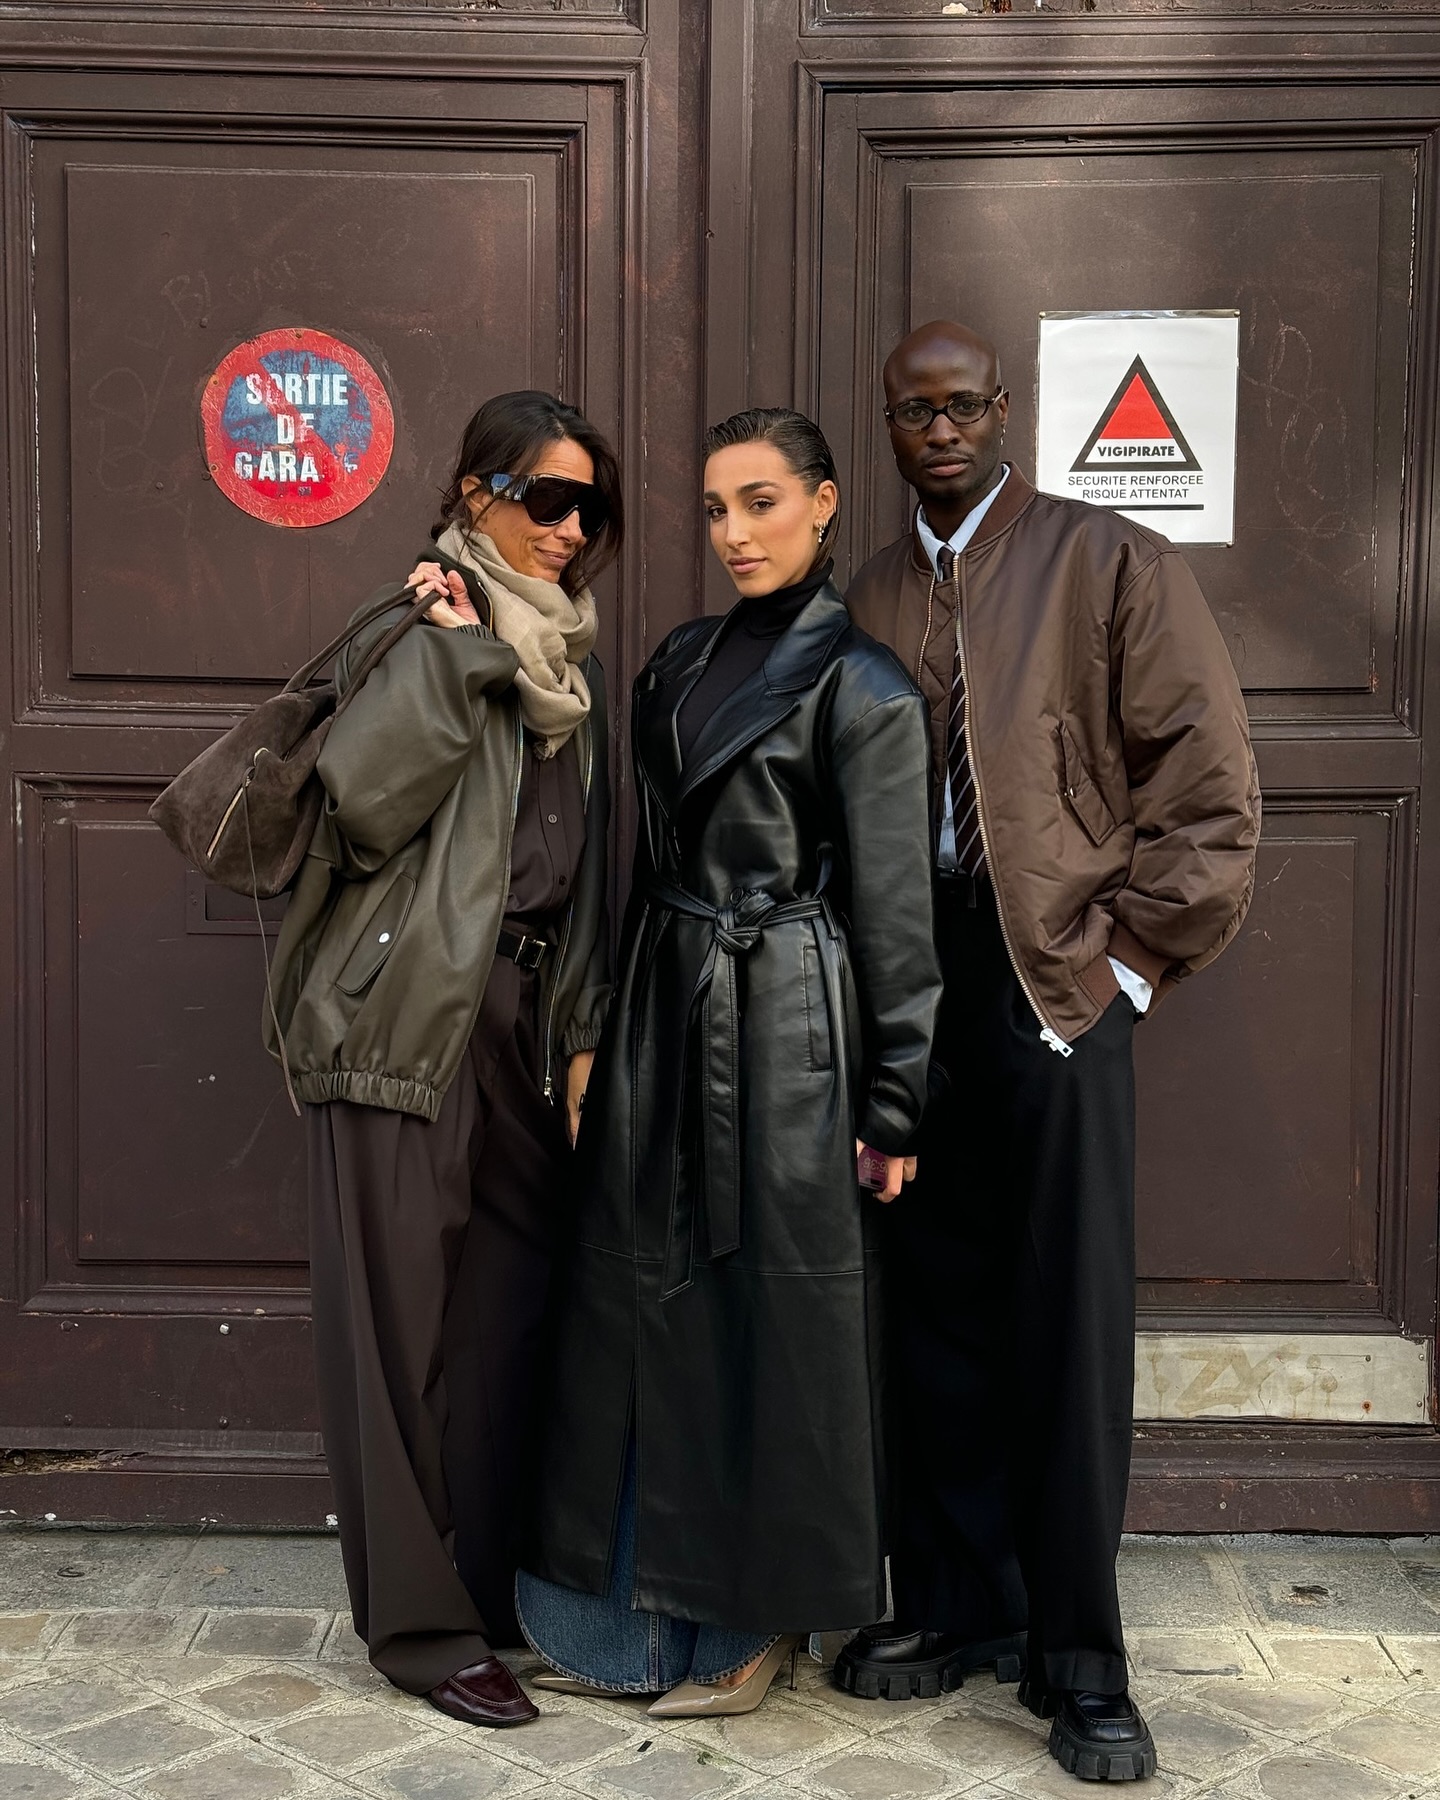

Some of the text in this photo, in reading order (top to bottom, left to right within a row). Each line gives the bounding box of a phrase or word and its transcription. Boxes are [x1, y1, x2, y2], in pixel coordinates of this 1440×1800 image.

[245, 372, 349, 406] SORTIE
[1097, 445, 1175, 457] VIGIPIRATE
[234, 450, 358, 483] GARA
[1067, 474, 1204, 486] SECURITE RENFORCEE
[1082, 488, 1190, 499] RISQUE ATTENTAT
